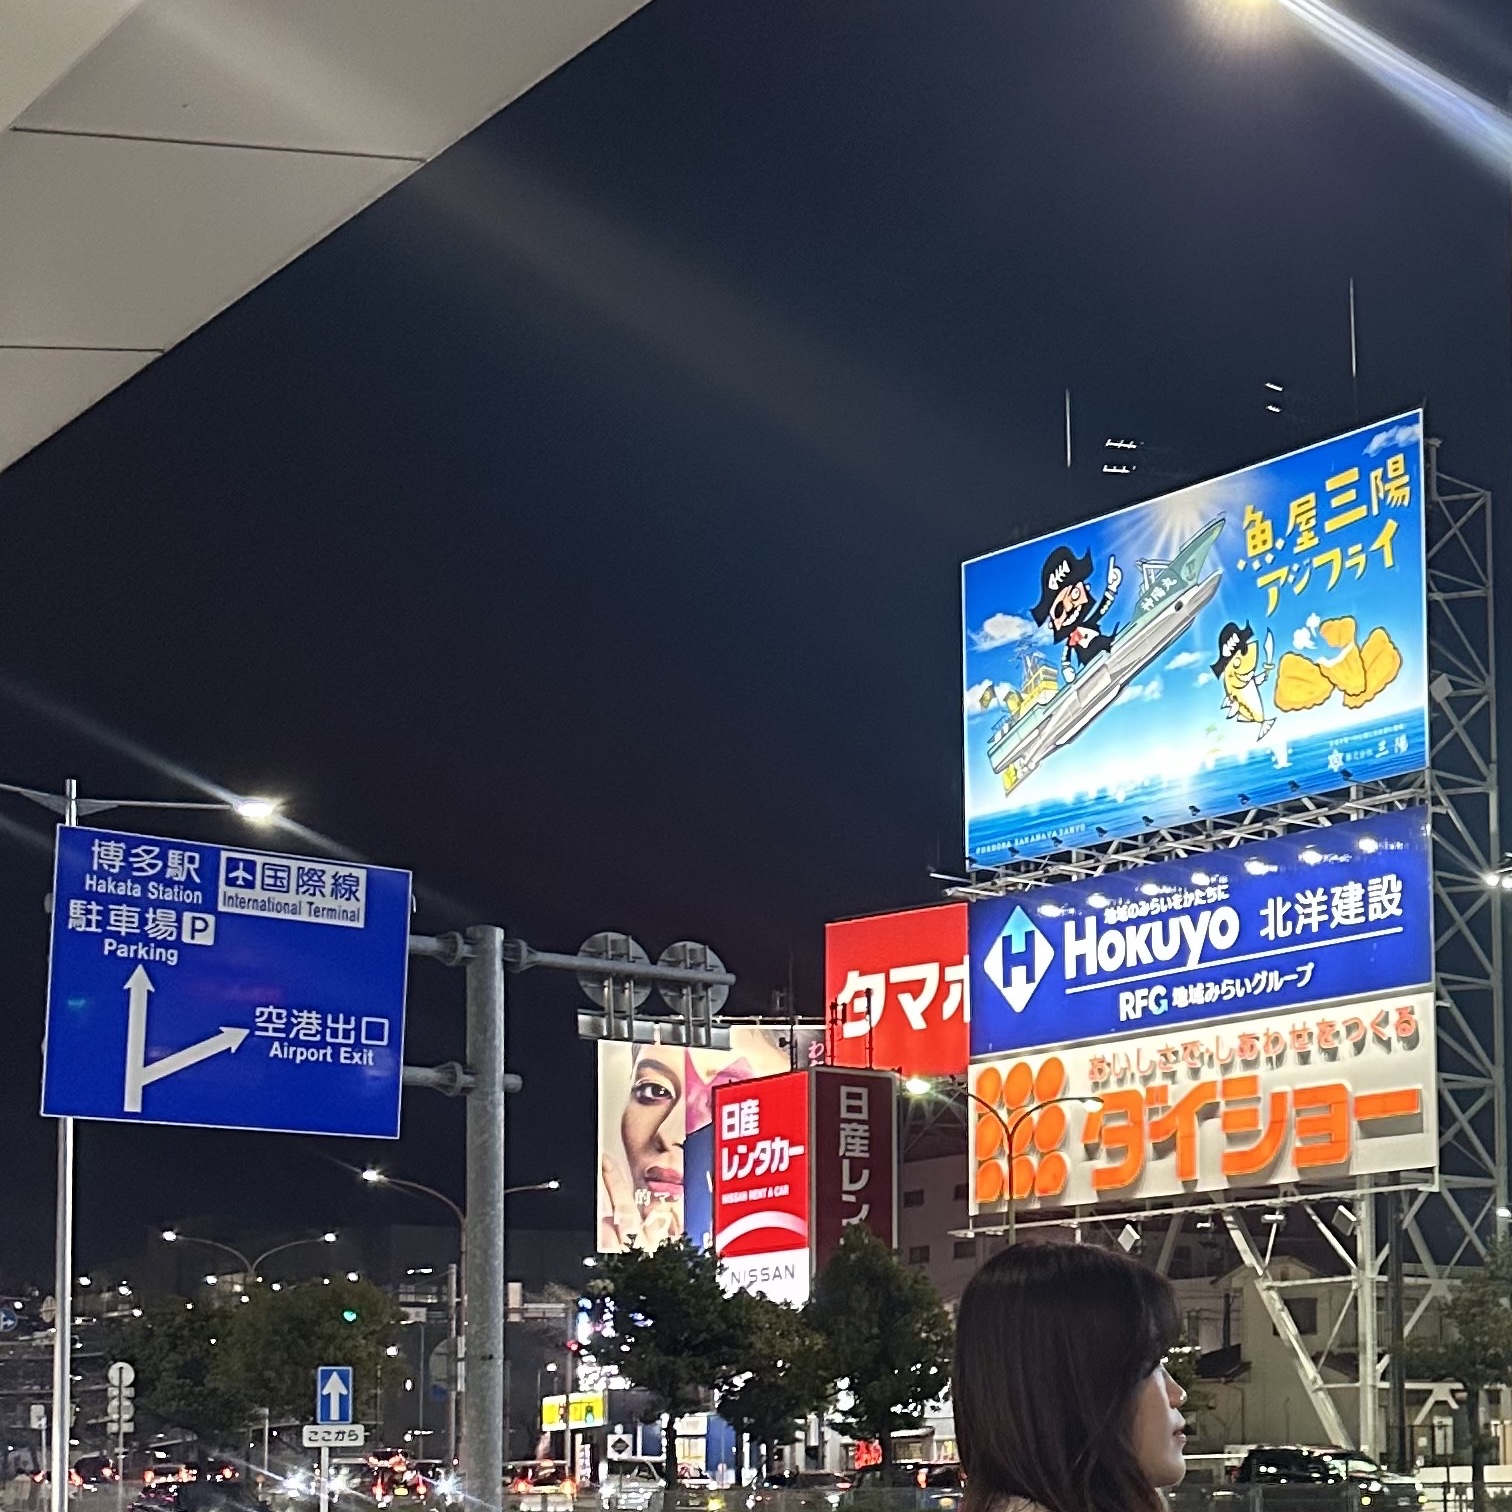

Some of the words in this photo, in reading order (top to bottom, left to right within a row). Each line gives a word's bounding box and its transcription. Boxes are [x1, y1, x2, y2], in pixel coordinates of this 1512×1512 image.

[1237, 454, 1412, 571] 魚屋三陽
[1257, 519, 1399, 618] アジフライ
[91, 839, 202, 884] 博多駅
[261, 863, 361, 902] 国際線
[85, 873, 142, 898] Hakata
[149, 884, 203, 905] Station
[222, 890, 302, 917] International
[306, 903, 361, 923] Terminal
[1260, 873, 1403, 941] 北洋建設
[68, 899, 178, 942] 駐車場
[103, 938, 178, 966] Parking
[1119, 985, 1168, 1022] RFG
[1172, 962, 1315, 1008] 地域みらいグループ
[254, 1005, 389, 1047] 空港出口
[269, 1042, 333, 1064] Airport
[339, 1046, 374, 1067] Exit
[721, 1098, 760, 1140] 日産
[1082, 1074, 1421, 1192] ダイショー
[721, 1136, 805, 1181] レンタカー
[839, 1085, 870, 1245] 日産レン
[731, 1264, 795, 1285] NISSAN
[307, 1429, 359, 1442] ここから
